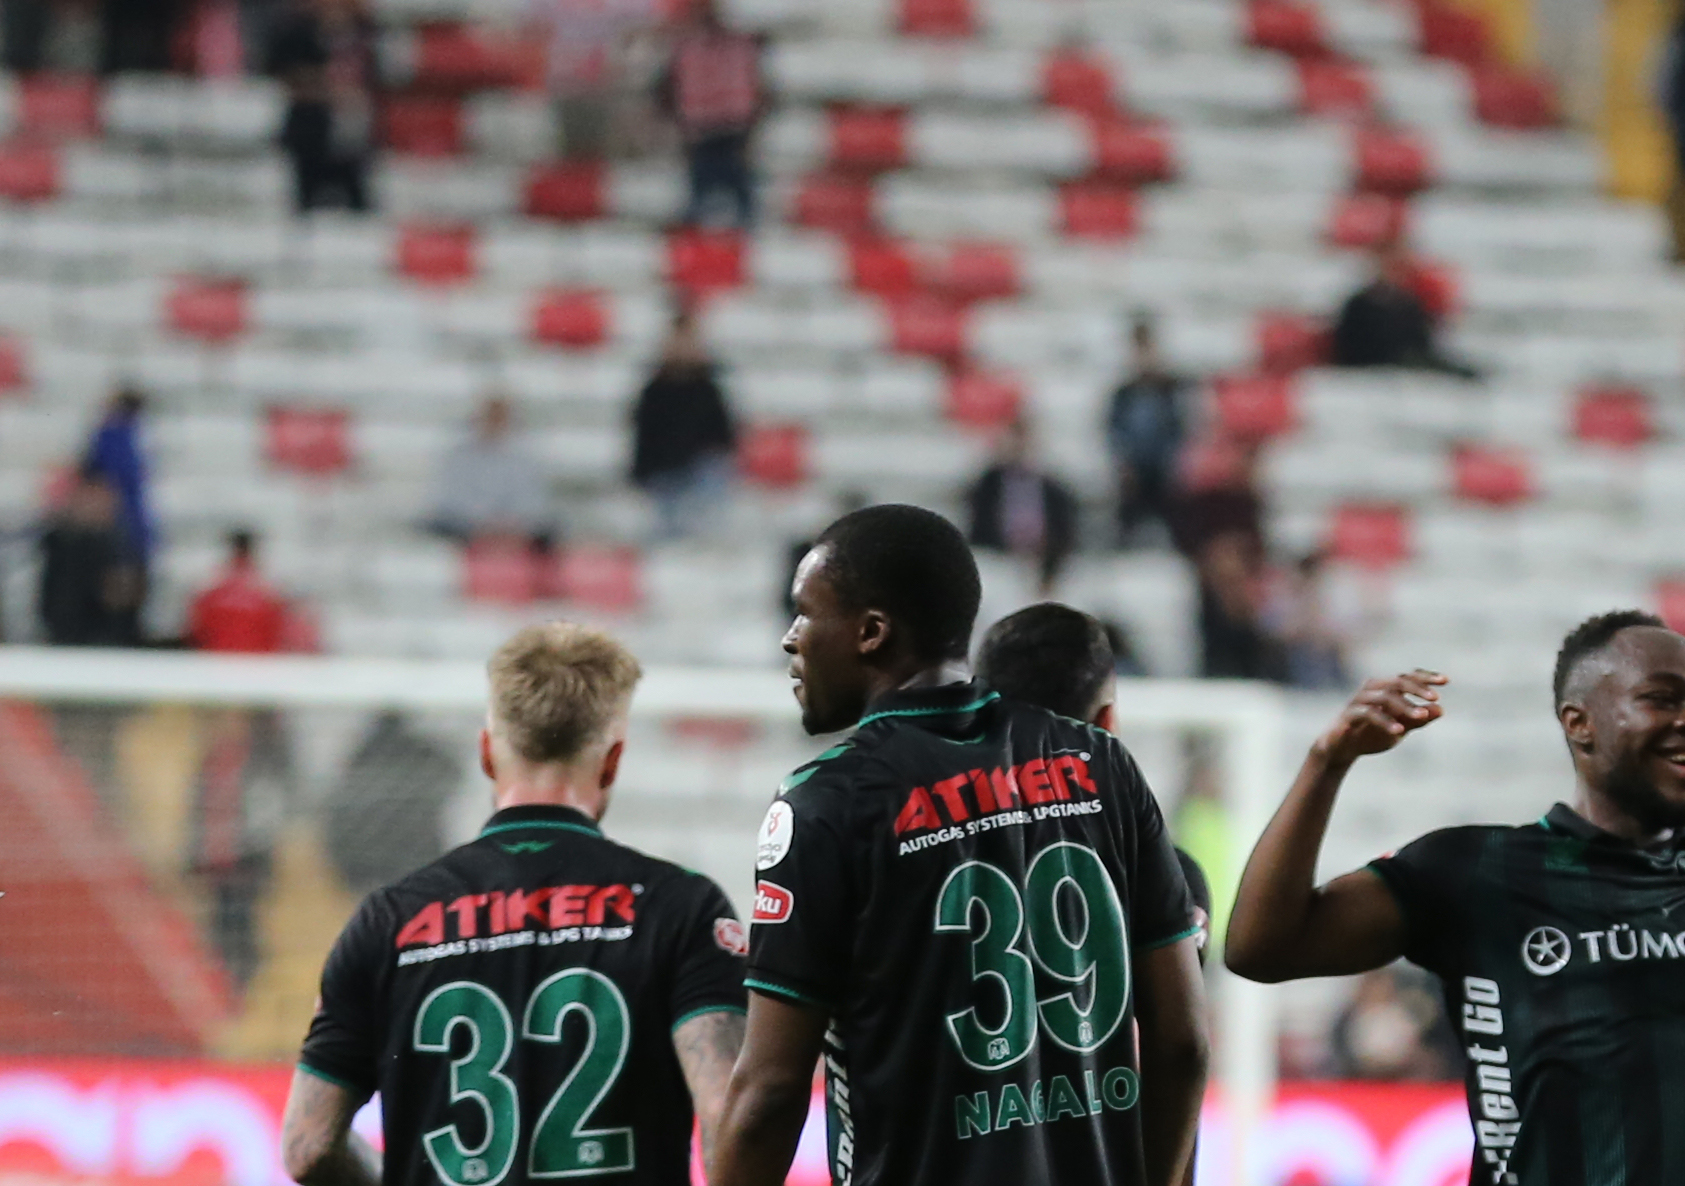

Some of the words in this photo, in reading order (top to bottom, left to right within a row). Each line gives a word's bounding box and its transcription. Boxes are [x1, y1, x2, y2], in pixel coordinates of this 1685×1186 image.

[894, 755, 1098, 837] ATIKER
[899, 826, 964, 857] AUTOGAS
[396, 883, 636, 949] ATIKER
[935, 841, 1132, 1072] 39
[955, 1066, 1139, 1139] NAGALO
[1476, 1045, 1522, 1148] Rent
